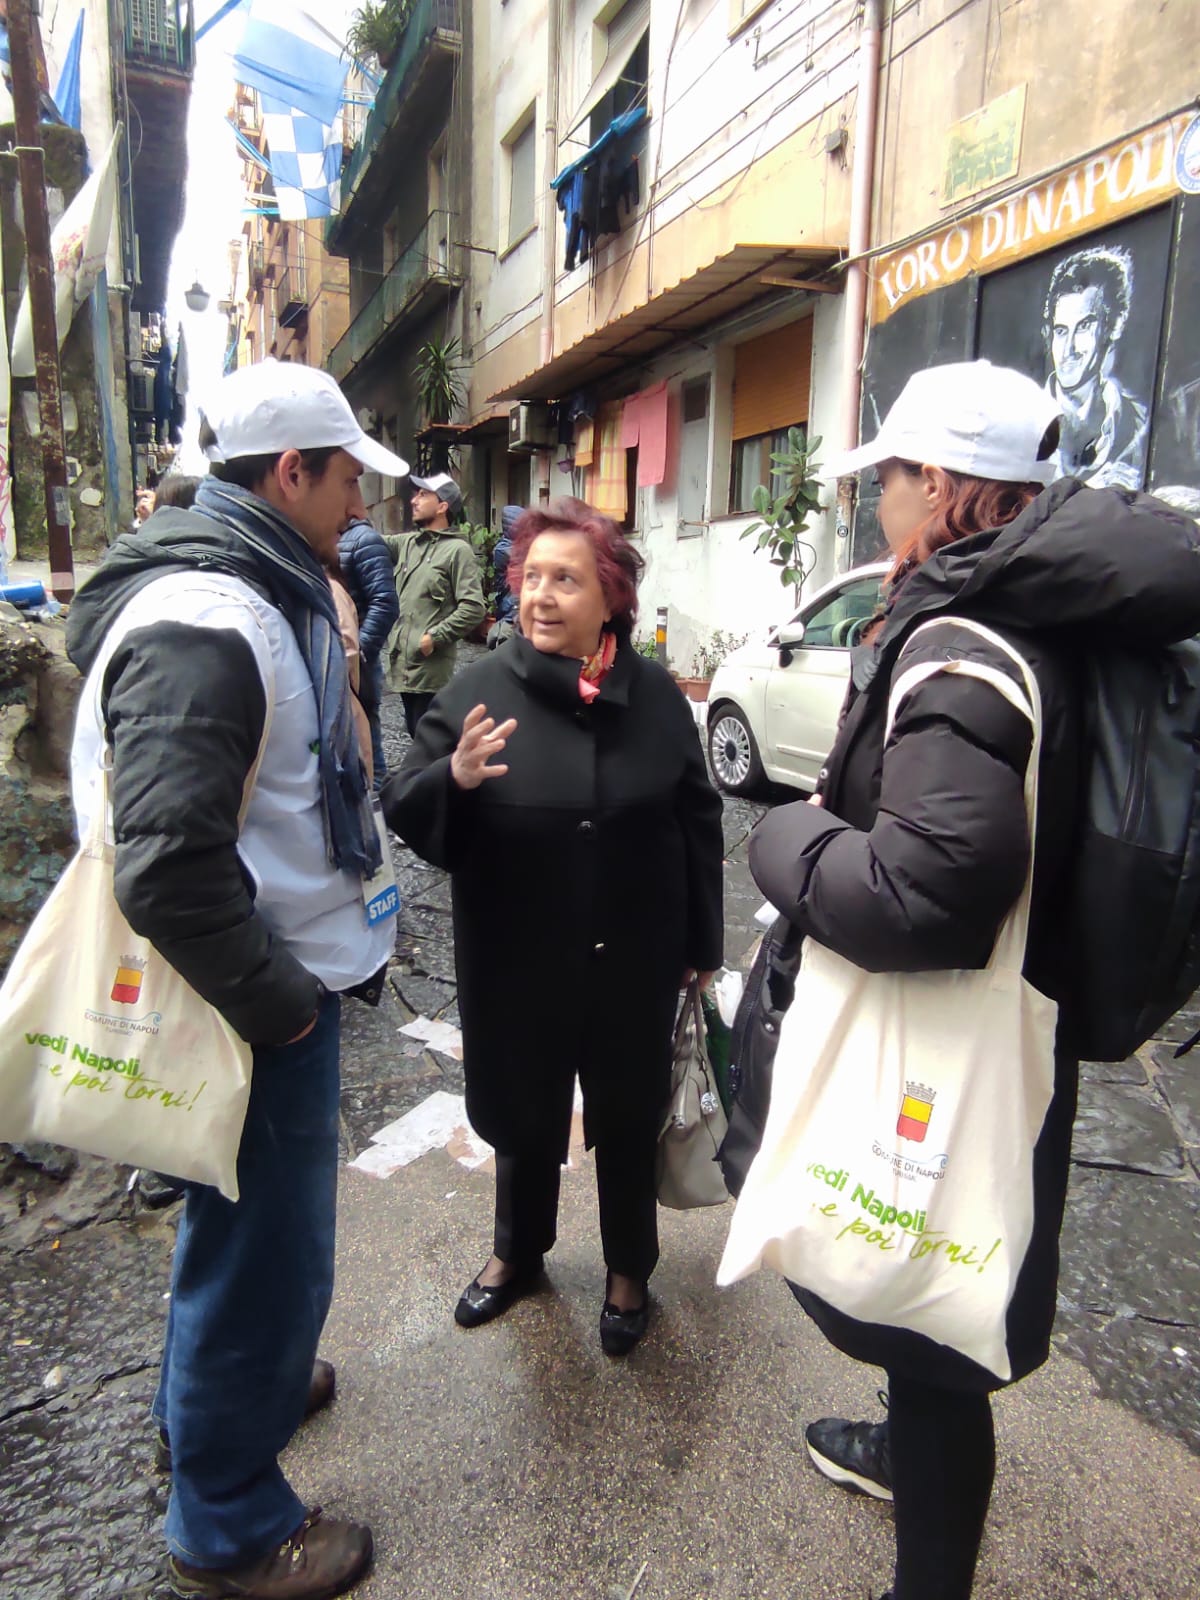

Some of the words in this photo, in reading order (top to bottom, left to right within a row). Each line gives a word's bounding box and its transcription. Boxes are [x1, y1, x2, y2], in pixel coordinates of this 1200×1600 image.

[979, 203, 1019, 259] DI
[1022, 120, 1181, 241] NAPOLI
[369, 892, 397, 919] STAFF
[84, 1011, 117, 1028] COMUNE
[119, 1020, 130, 1030] DI
[130, 1022, 160, 1035] NAPOLI
[24, 1032, 69, 1055] vedi
[71, 1043, 141, 1077] Napoli
[63, 1070, 113, 1096] poi
[120, 1072, 208, 1112] torni!
[904, 1162, 915, 1172] DI
[915, 1166, 946, 1180] NAPOLI
[806, 1162, 850, 1192] vedi
[850, 1183, 927, 1232] Napoli
[836, 1217, 896, 1250] poi
[903, 1231, 1002, 1274] torni!
